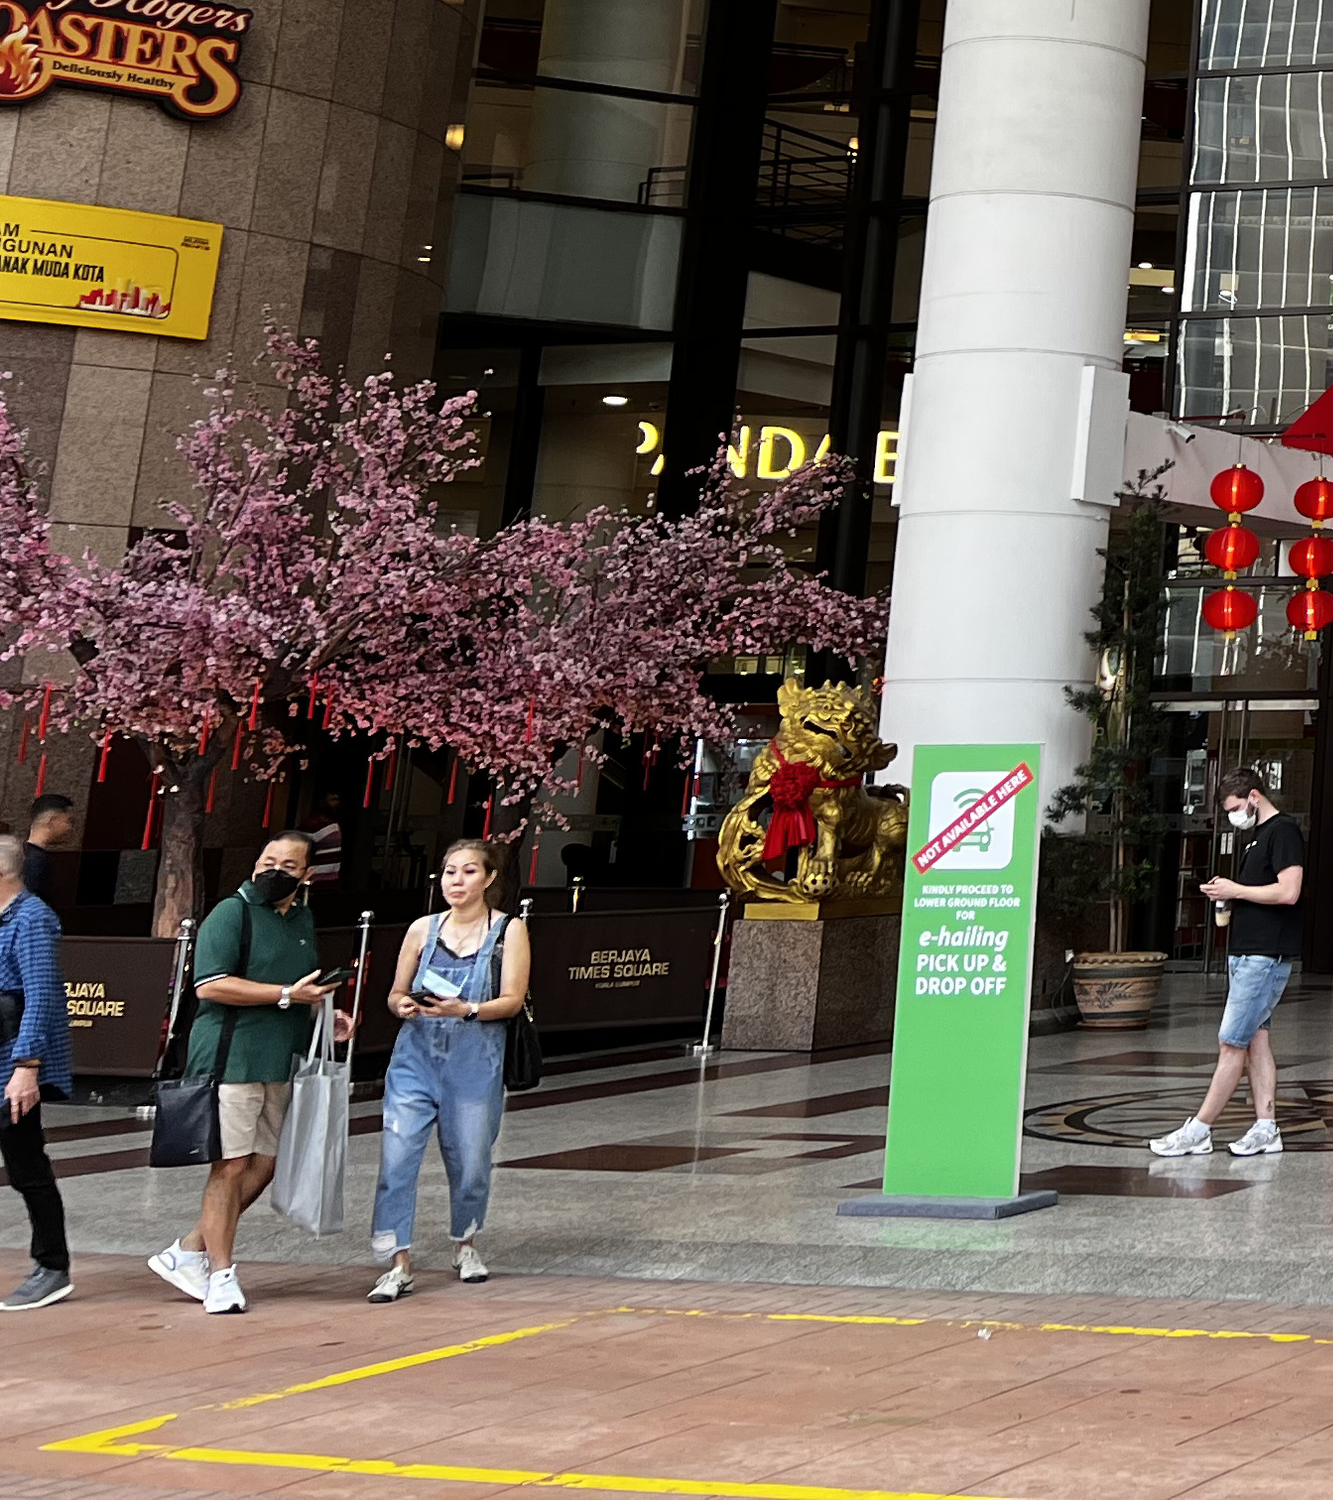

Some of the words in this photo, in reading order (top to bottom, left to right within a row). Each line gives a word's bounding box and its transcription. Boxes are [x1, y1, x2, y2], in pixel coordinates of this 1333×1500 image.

[52, 60, 123, 82] Deliciously
[127, 72, 176, 90] Healthy
[0, 222, 21, 238] M
[0, 238, 73, 259] GUNAN
[32, 259, 70, 279] MUDA
[73, 264, 104, 283] KOTA
[917, 841, 942, 867] NOT
[941, 795, 998, 848] AVAILABLE
[996, 769, 1028, 800] HERE
[922, 885, 955, 894] KINDLY
[956, 885, 999, 894] PROCEED
[1001, 884, 1014, 894] TO
[914, 898, 946, 907] LOWER
[947, 898, 987, 907] GROUND
[989, 898, 1020, 907] FLOOR
[956, 910, 975, 920] FOR
[919, 925, 1009, 952] e-hailing
[590, 949, 651, 964] BERJAYA
[917, 954, 959, 972] PICK
[963, 954, 989, 972] UP
[992, 954, 1007, 972] &
[568, 964, 611, 980] TIMES
[613, 962, 670, 978] SQUARE
[916, 977, 967, 995] DROP
[970, 977, 1007, 995] OFF
[66, 1000, 125, 1016] SQUARE
